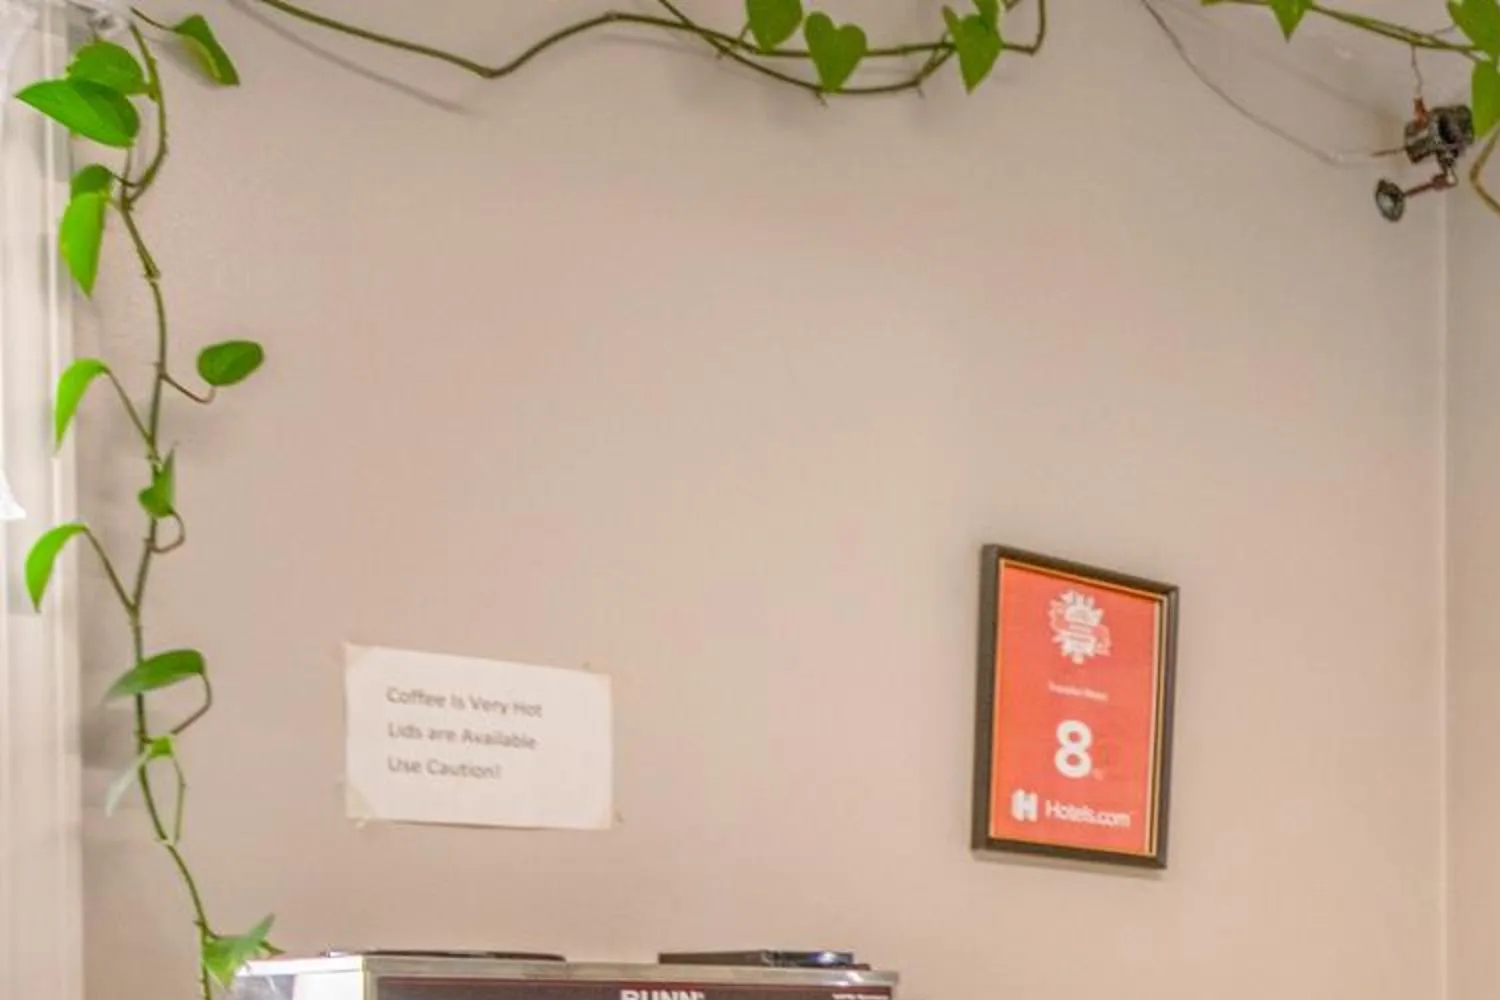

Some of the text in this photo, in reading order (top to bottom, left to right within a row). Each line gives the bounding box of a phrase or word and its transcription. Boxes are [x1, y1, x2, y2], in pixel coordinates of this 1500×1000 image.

[386, 686, 447, 709] Coffee
[469, 694, 508, 715] Very
[514, 700, 543, 718] Hot
[387, 722, 537, 750] Lids are Available
[1053, 719, 1093, 779] 8
[387, 756, 501, 780] Use Caution!
[1045, 799, 1131, 828] Hotels.com
